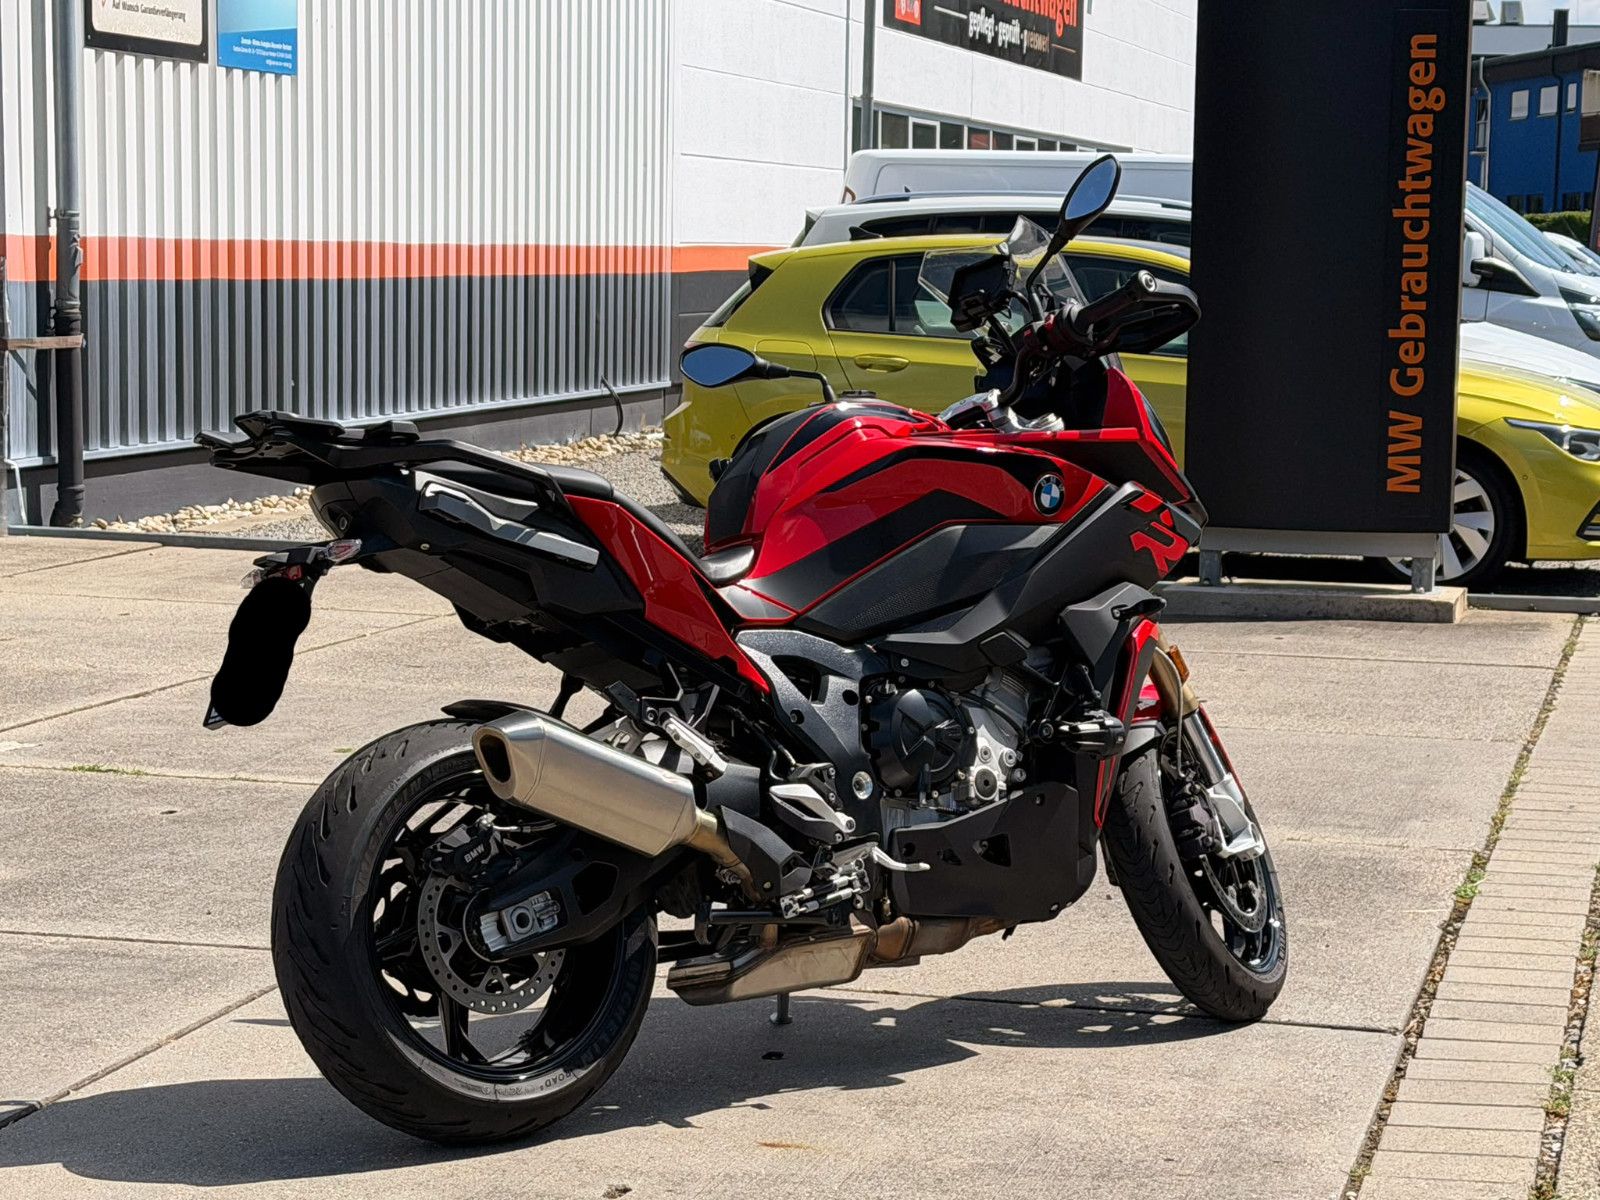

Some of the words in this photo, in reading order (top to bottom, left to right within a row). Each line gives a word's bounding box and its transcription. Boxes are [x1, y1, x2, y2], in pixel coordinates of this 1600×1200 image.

[1387, 33, 1446, 397] Gebrauchtwagen
[1386, 410, 1423, 494] MW
[464, 843, 485, 863] BMW
